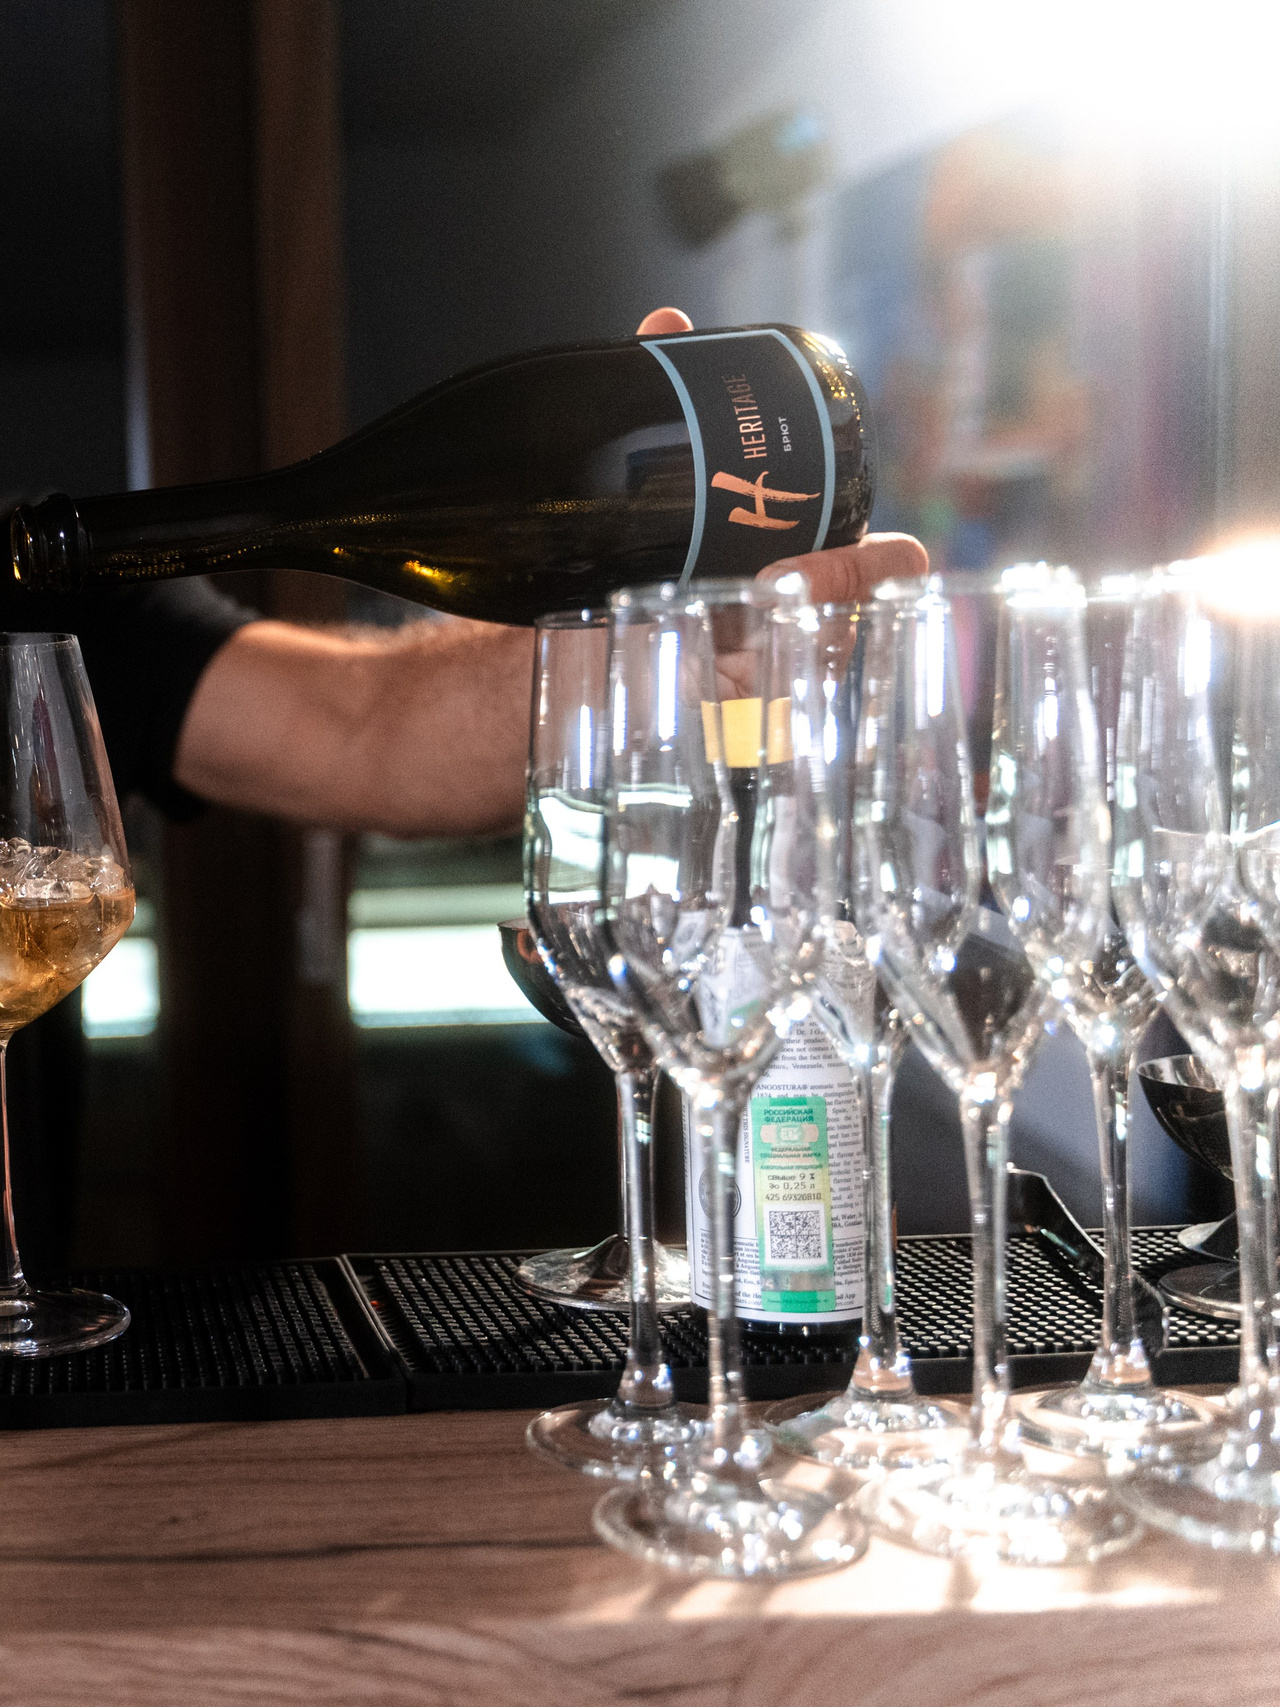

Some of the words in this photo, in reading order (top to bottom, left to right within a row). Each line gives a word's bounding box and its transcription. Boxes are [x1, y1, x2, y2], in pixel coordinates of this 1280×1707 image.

[721, 373, 767, 459] HERITAGE
[778, 416, 792, 452] БРЮТ
[763, 1107, 814, 1115] РОССИЙСКАЯ
[764, 1115, 814, 1123] ФЕДЕРАЦИЯ
[799, 1172, 806, 1181] 9
[783, 1181, 806, 1190] 0,25
[765, 1193, 780, 1201] 425
[782, 1192, 822, 1201] 69320810
